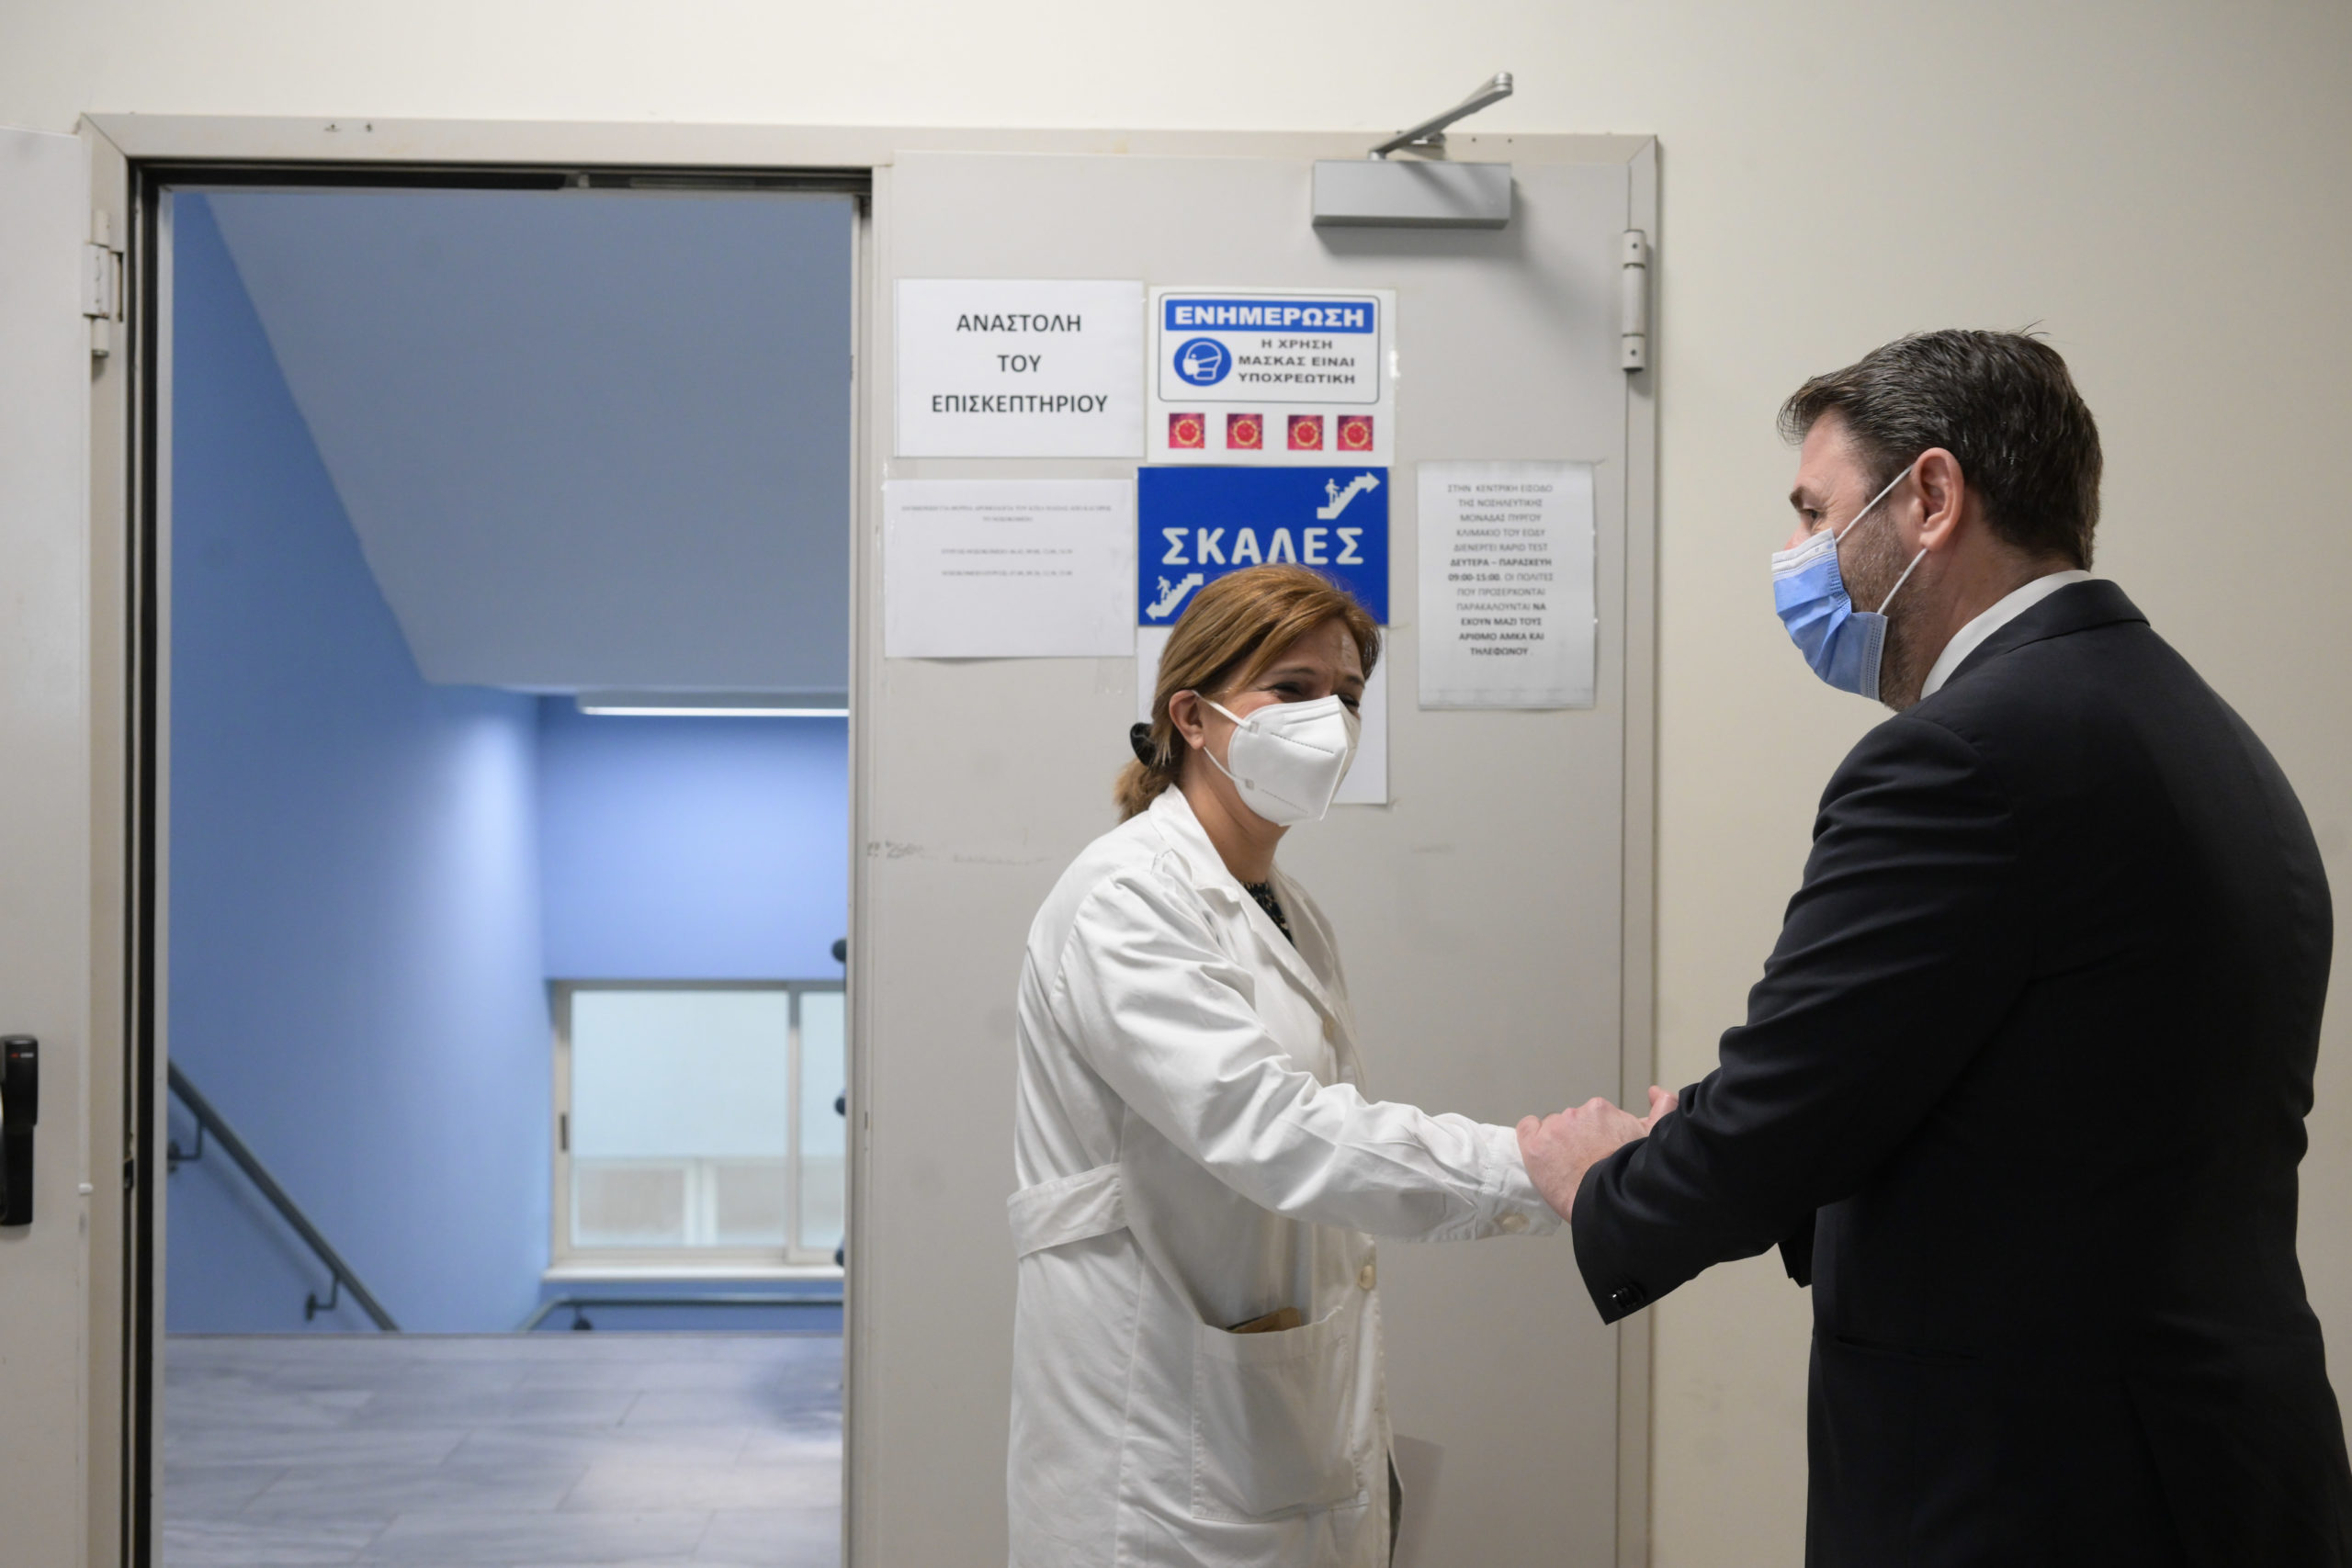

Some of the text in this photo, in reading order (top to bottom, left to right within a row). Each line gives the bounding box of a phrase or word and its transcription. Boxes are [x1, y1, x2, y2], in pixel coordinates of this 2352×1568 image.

[1174, 305, 1364, 328] ΕΝΗΜΕΡΩΣΗ
[956, 313, 1081, 333] ΑΝΑΣΤΟΛΗ
[1261, 338, 1333, 350] Η ΧΡΗΣΗ
[997, 354, 1042, 374] ΤΟΥ
[1238, 355, 1355, 367] ΜΑΣΚΑΣ ΕΙΝΑΙ
[1238, 373, 1356, 385] ΥΠΟΧΡΕΩΤΙΚΗ
[931, 394, 1109, 414] ΕΠΙΣΚΕΠΤΗΡΙΟΥ
[1447, 484, 1472, 493] ΣΤΗΝ
[1521, 484, 1553, 493] ΕΙΣΟΔΟ
[1459, 499, 1475, 507] ΤΗΣ
[1460, 513, 1542, 522] ΜΟΝΑΔΑΣ ΠΥΡΓΟΥ
[1503, 528, 1520, 537] ΤΟΥ
[1161, 527, 1363, 566] ΣΚΑΛΕΣ
[1450, 558, 1489, 567] ΔΕΥΤΕΡΑ
[1498, 558, 1552, 567] ΠΑΡΑΣΚΕΥΗ
[1457, 588, 1476, 596] ΠΟΥ
[1457, 603, 1546, 611] ΠΑΡΑΚΑΛΟΥΝΤΑΙ ΝΑ
[1461, 617, 1542, 626] ΕΧΟΥΝ ΜΑΖΙ ΤΟΥΣ
[1459, 632, 1544, 641] ΑΡΙΘΜΟ ΑΜΚΑ ΚΑΙ
[1470, 647, 1529, 656] ΤΗΛΕΦΩΝΟΥ
